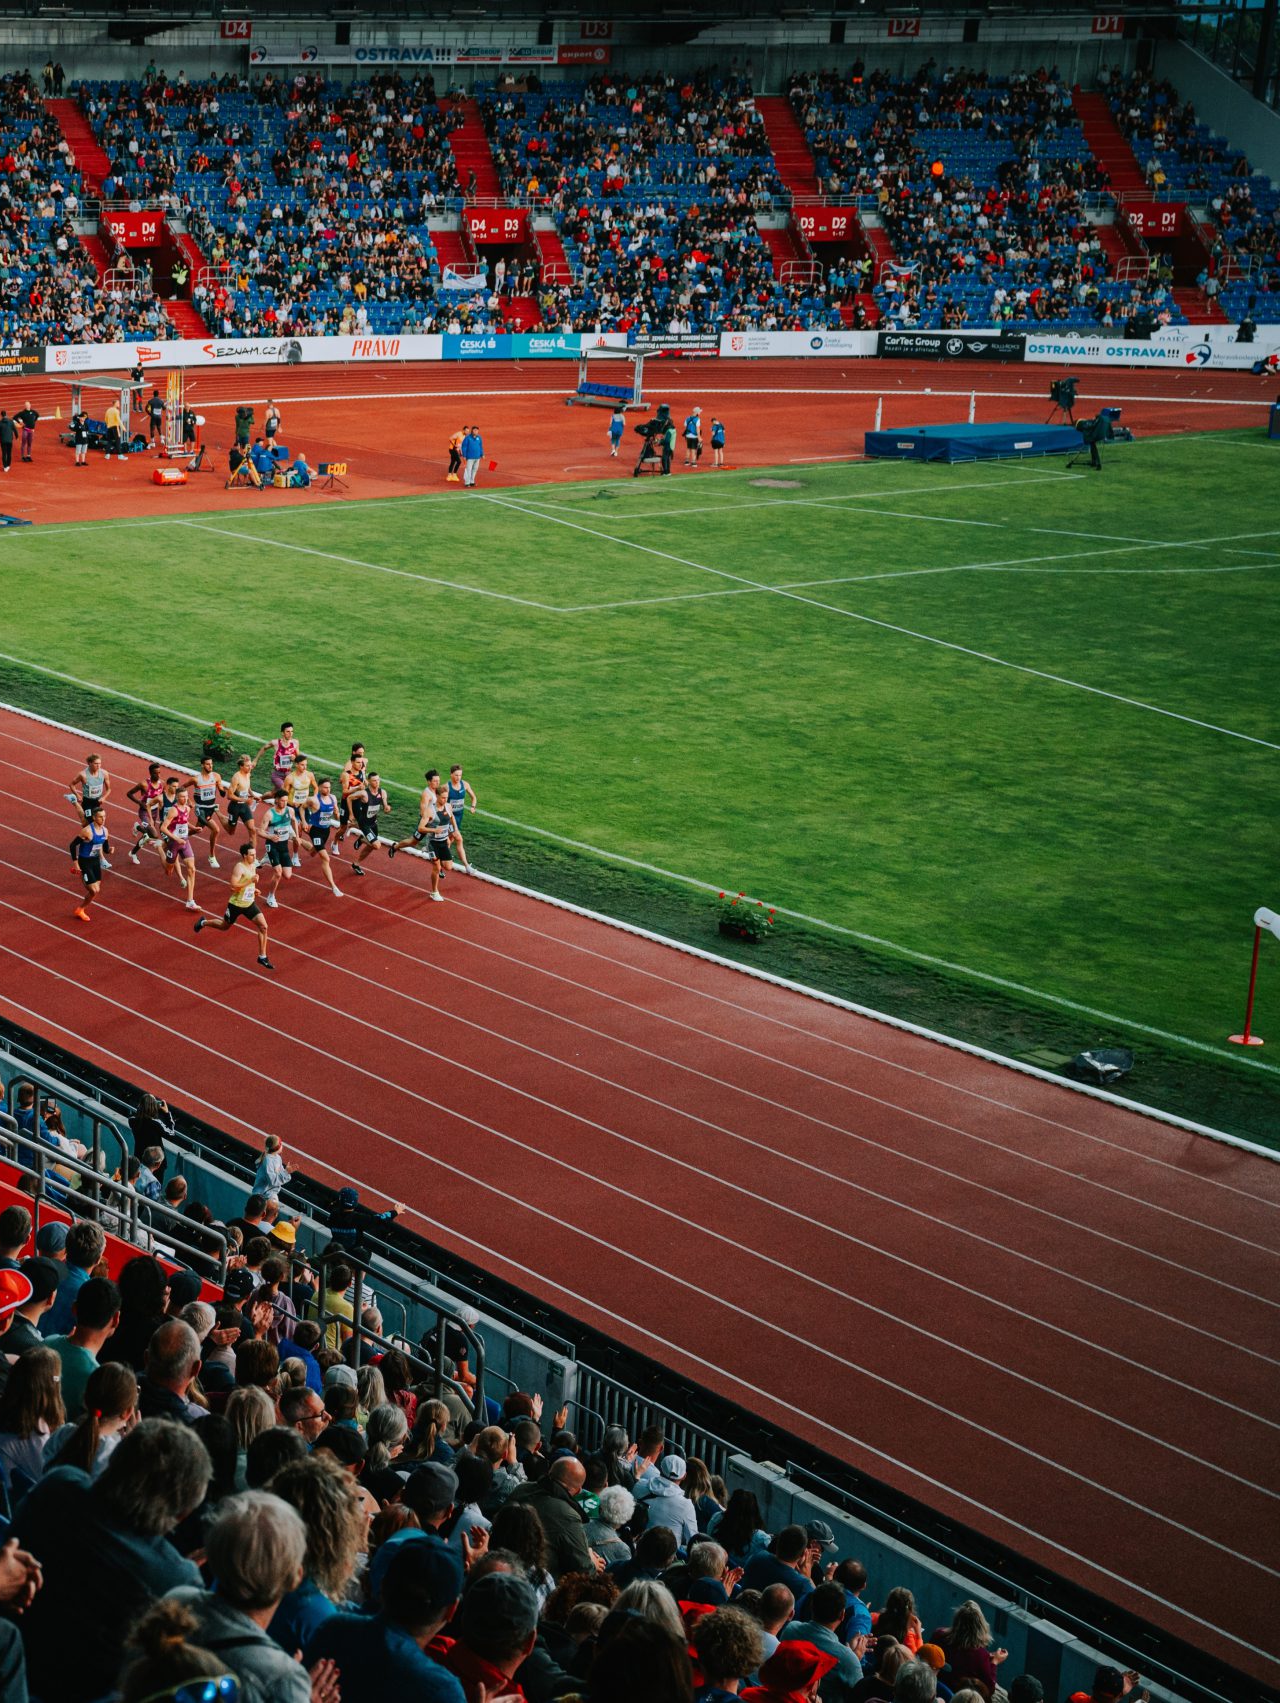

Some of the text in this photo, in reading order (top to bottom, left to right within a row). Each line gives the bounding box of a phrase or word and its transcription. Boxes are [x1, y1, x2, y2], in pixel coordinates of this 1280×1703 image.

[225, 21, 247, 36] D4
[585, 21, 608, 36] D3
[893, 19, 916, 34] D2
[1097, 15, 1119, 31] D1
[355, 48, 451, 61] OSTRAVA!!!
[800, 217, 847, 229] D3 D2
[1162, 212, 1176, 225] D1
[111, 222, 156, 235] D5 D4
[472, 219, 519, 231] D4 D3
[352, 337, 400, 357] PRÁVO
[460, 339, 486, 349] ČESKÁ
[529, 337, 556, 348] ČESKÁ
[885, 336, 940, 348] CarTec Group
[11, 349, 20, 357] KE
[1029, 344, 1099, 356] OSTRAVA!!!
[1106, 346, 1180, 358] OSTRAVA!!!
